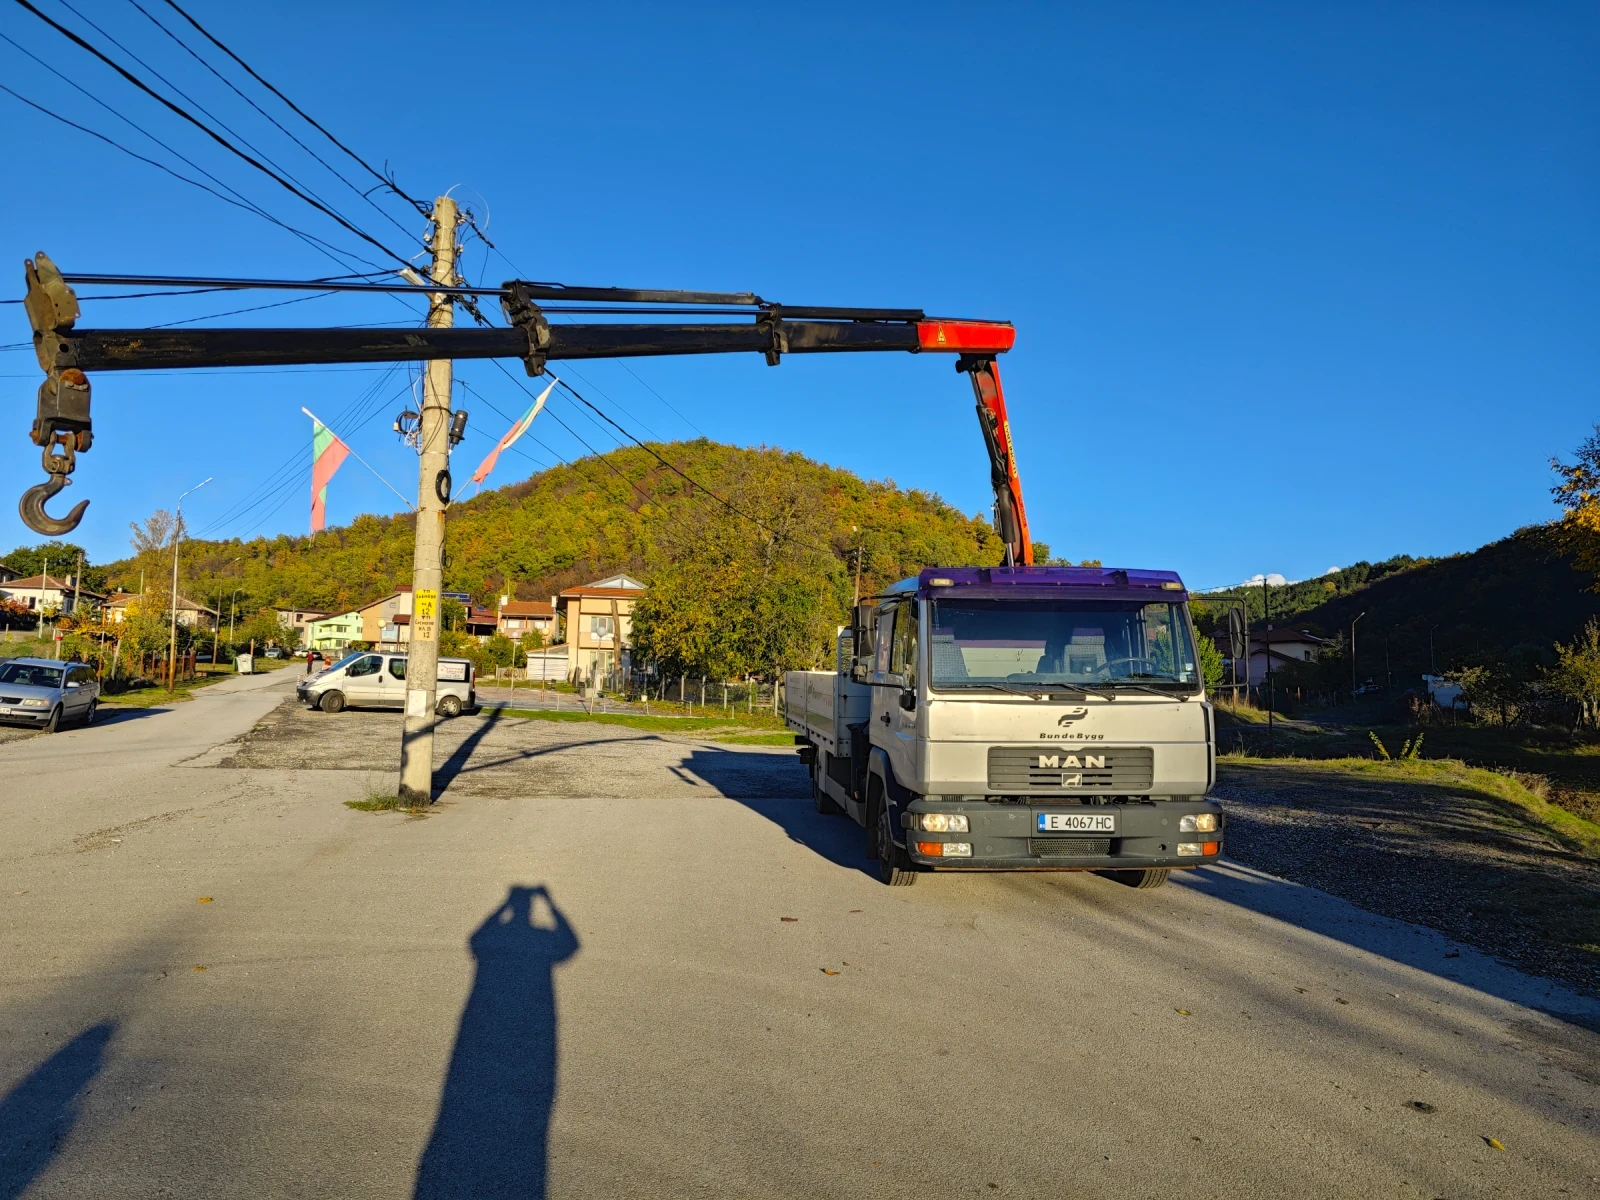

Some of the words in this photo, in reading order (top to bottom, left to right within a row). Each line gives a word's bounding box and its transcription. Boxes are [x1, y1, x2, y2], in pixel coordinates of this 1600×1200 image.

[1038, 755, 1106, 769] MAN
[1051, 816, 1059, 829] E
[1065, 816, 1094, 829] 4067
[1095, 816, 1112, 830] HC
